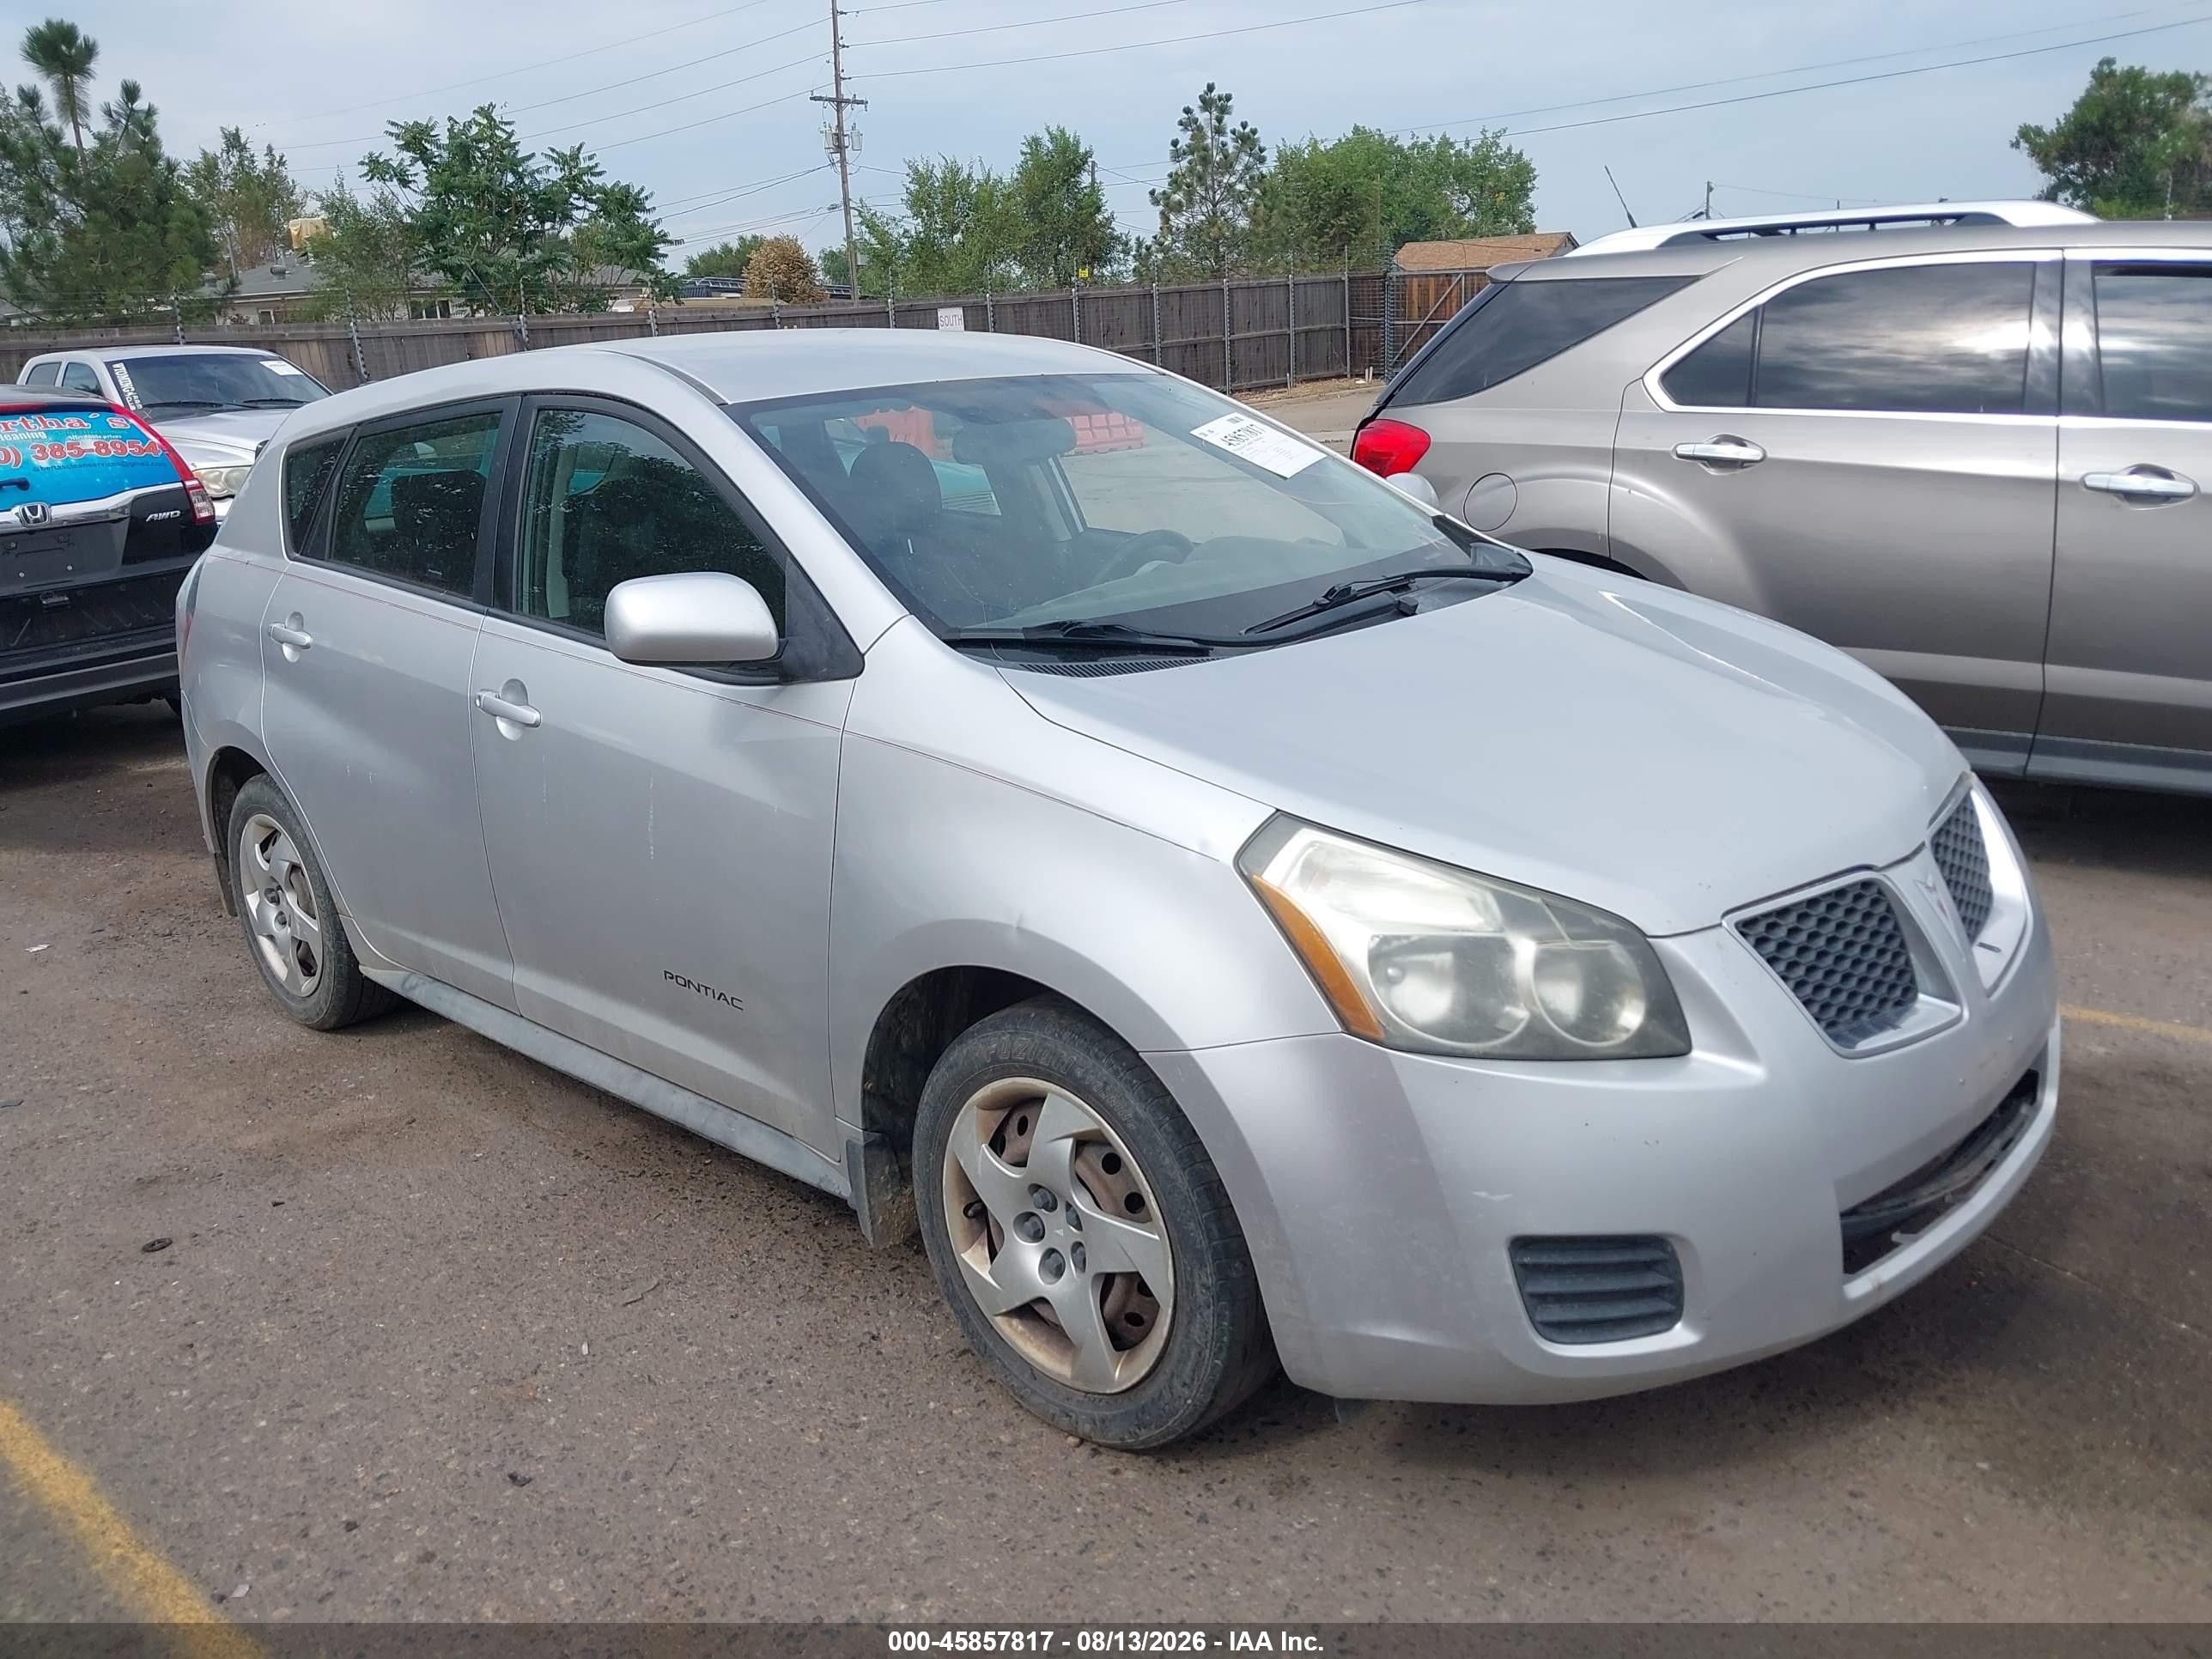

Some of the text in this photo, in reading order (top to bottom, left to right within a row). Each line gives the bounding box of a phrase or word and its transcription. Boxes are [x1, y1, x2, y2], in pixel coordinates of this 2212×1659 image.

[939, 314, 963, 327] SOUTH
[1220, 423, 1266, 447] 45857817
[29, 439, 161, 462] 385-8954
[146, 510, 180, 522] AWD
[663, 969, 744, 1011] PONTIAC
